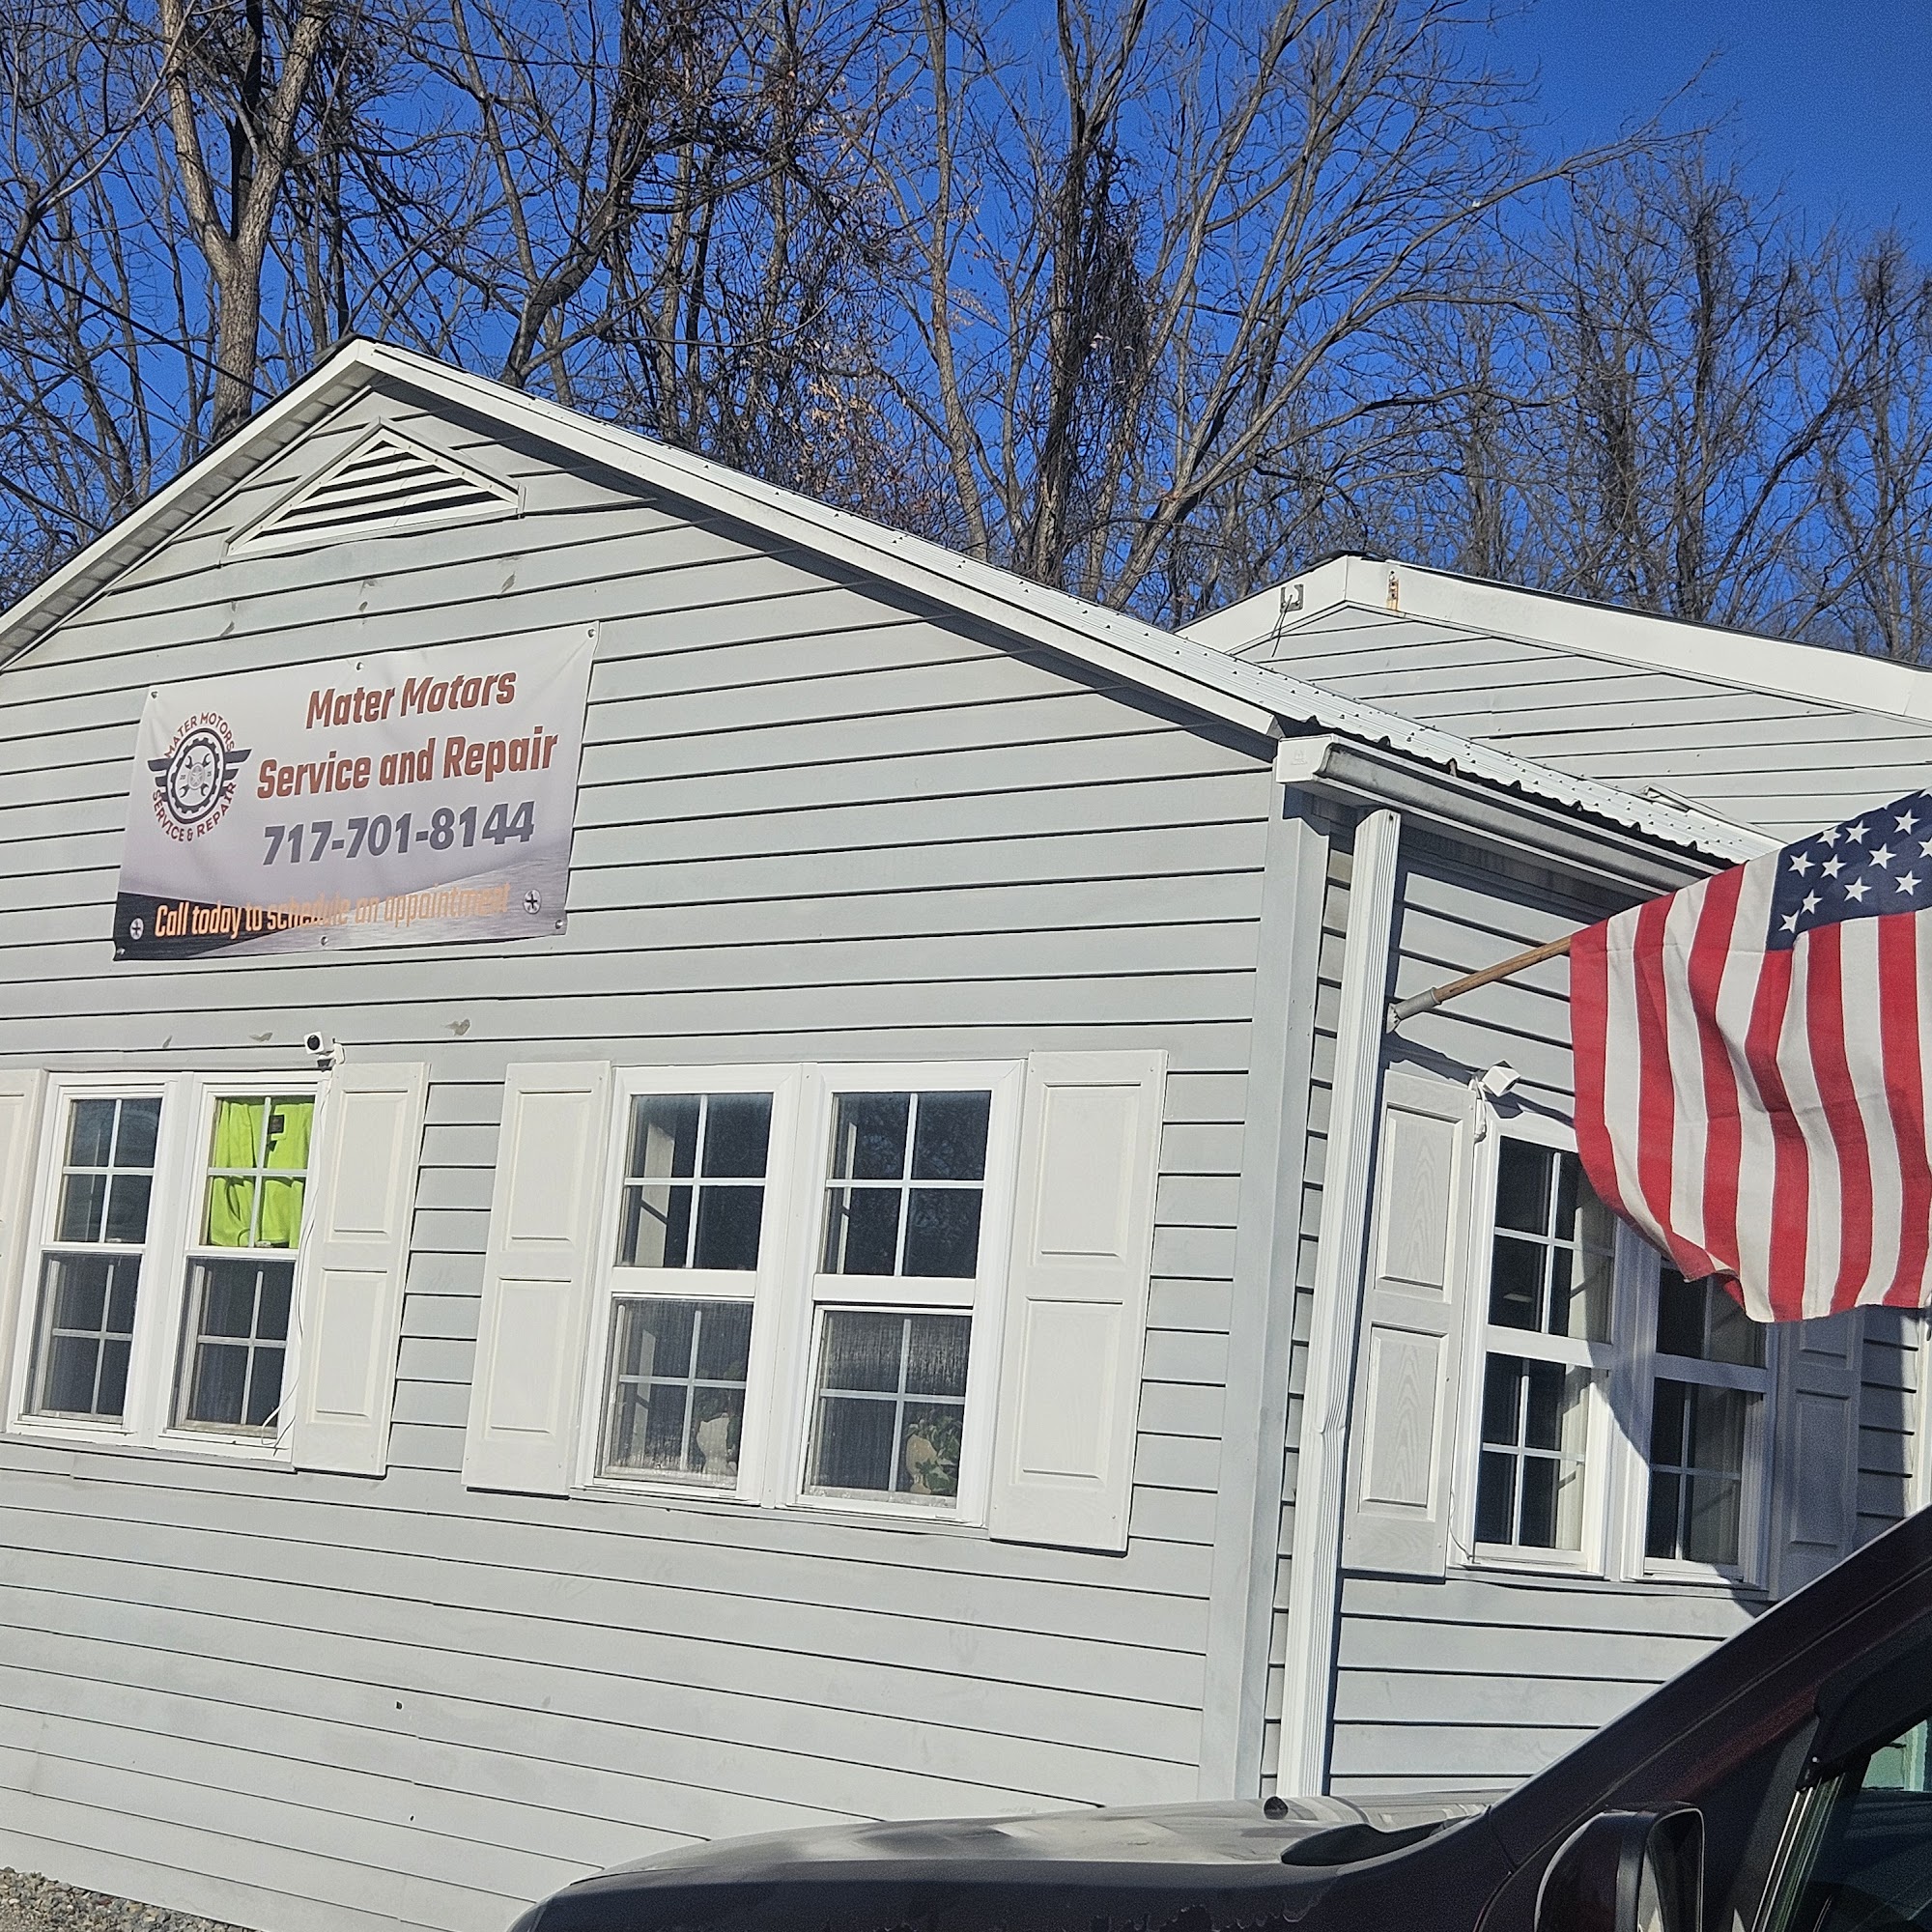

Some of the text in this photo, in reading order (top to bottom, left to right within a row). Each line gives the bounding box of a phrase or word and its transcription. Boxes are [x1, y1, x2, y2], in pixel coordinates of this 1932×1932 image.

[305, 671, 517, 729] Mater Motors
[164, 712, 235, 758] MATER MOTORS
[257, 725, 558, 799] Service and Repair
[153, 781, 237, 842] SERVICE & REPAIR
[263, 801, 535, 866] 717-701-8144
[155, 900, 189, 937] Call
[192, 899, 242, 939] today
[245, 902, 263, 931] to
[355, 896, 381, 923] an
[384, 882, 511, 927] appointment
